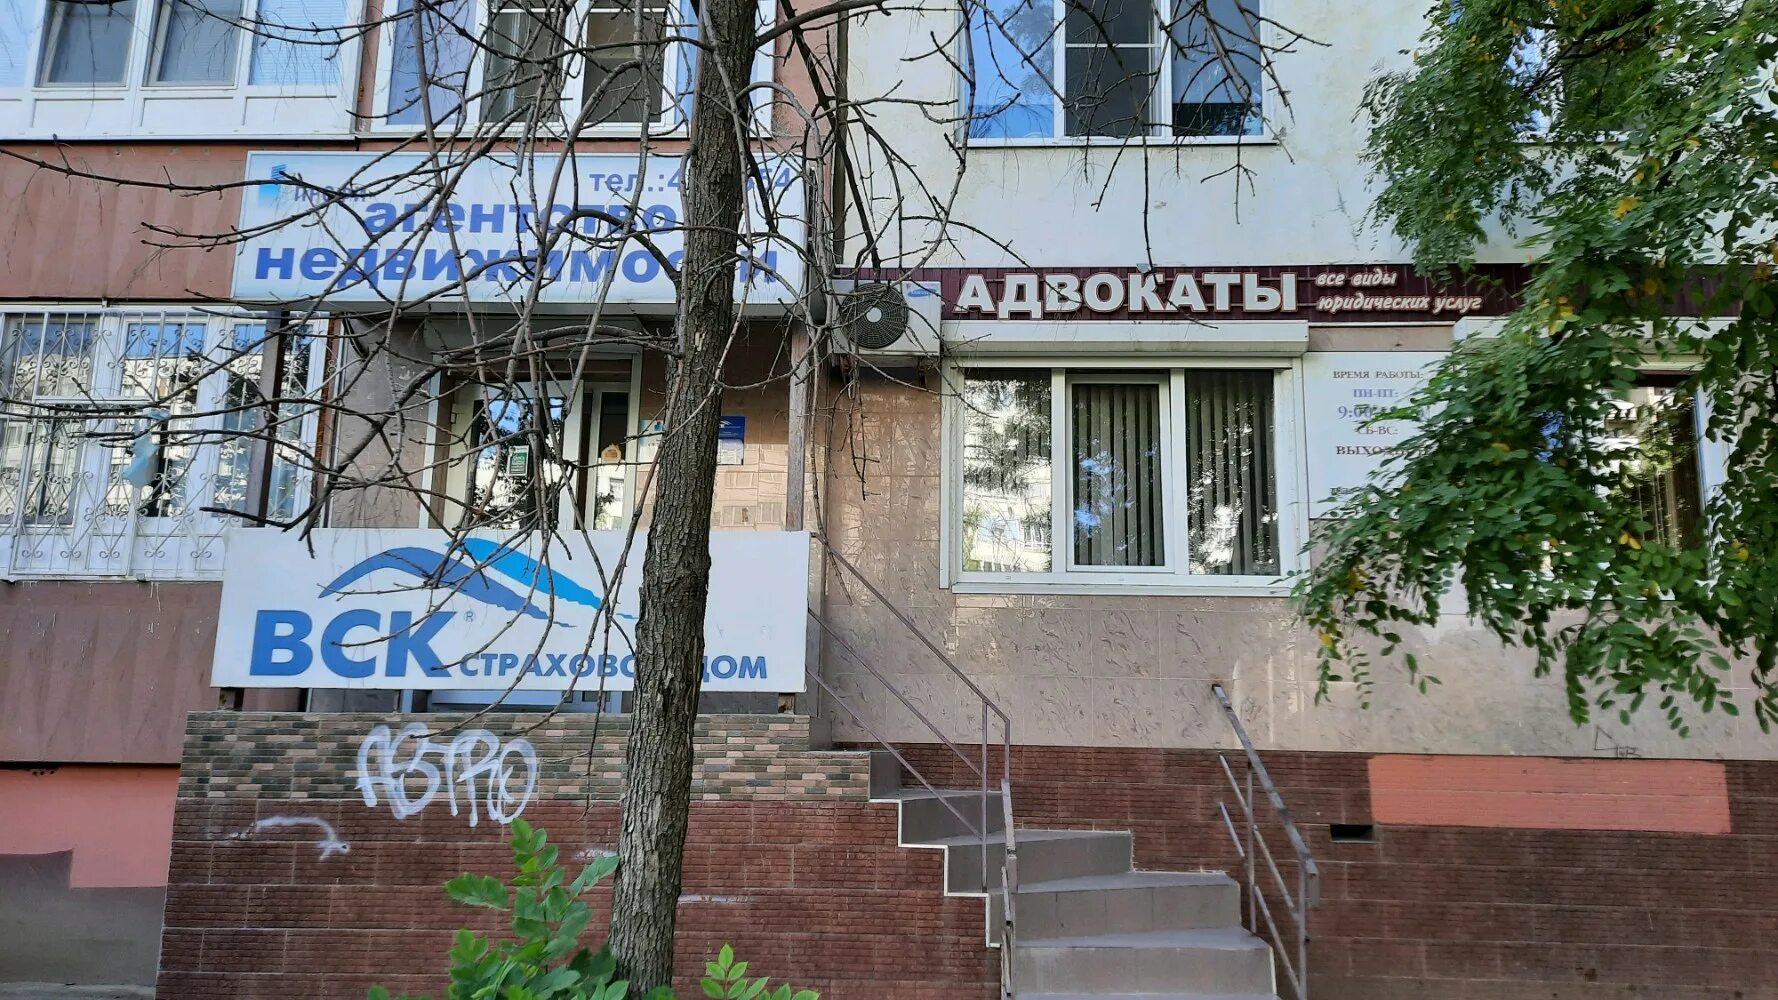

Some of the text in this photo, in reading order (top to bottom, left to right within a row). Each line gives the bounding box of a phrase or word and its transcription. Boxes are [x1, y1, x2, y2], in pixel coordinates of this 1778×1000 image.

[1316, 268, 1397, 287] все виды
[952, 272, 1298, 319] АДВОКАТЫ
[1317, 292, 1483, 315] юридических услуг
[1333, 371, 1425, 379] ВРЕМЯ РАБОТЫ:
[1353, 389, 1399, 398] ПН-ПТ:
[249, 609, 457, 679] ВСК
